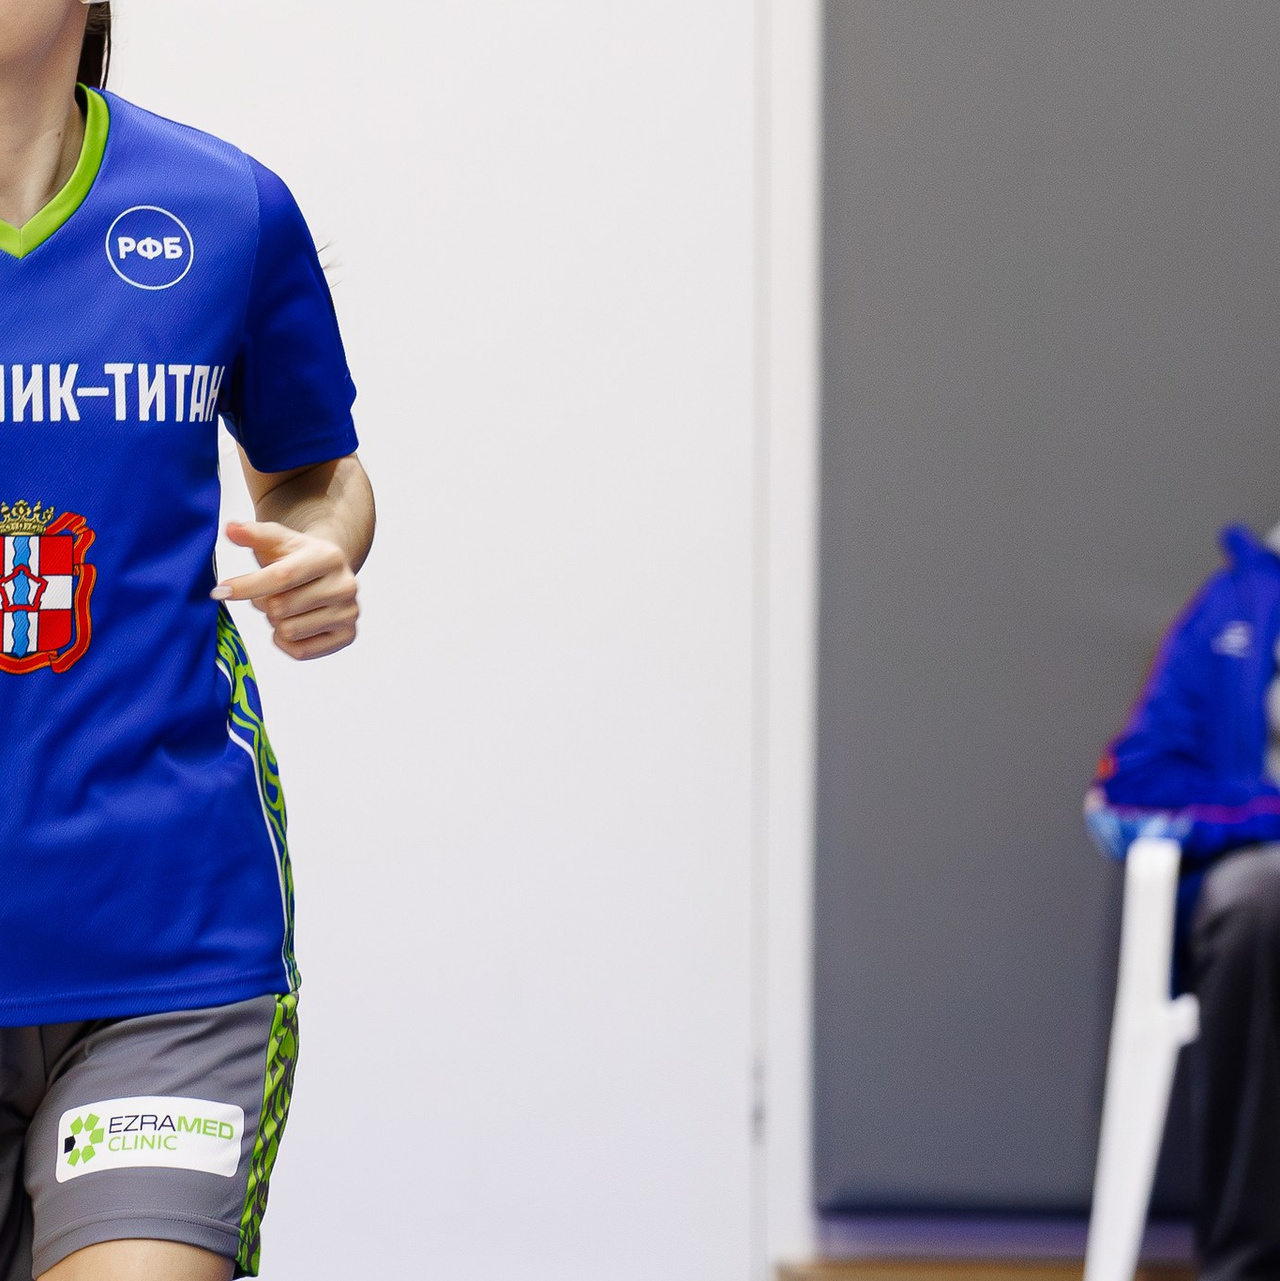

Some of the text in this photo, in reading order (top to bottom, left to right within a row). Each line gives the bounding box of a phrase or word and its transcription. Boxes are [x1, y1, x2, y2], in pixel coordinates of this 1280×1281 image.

[118, 237, 183, 260] РФБ
[108, 1114, 235, 1140] EZRAMED
[108, 1134, 178, 1152] CLINIC
